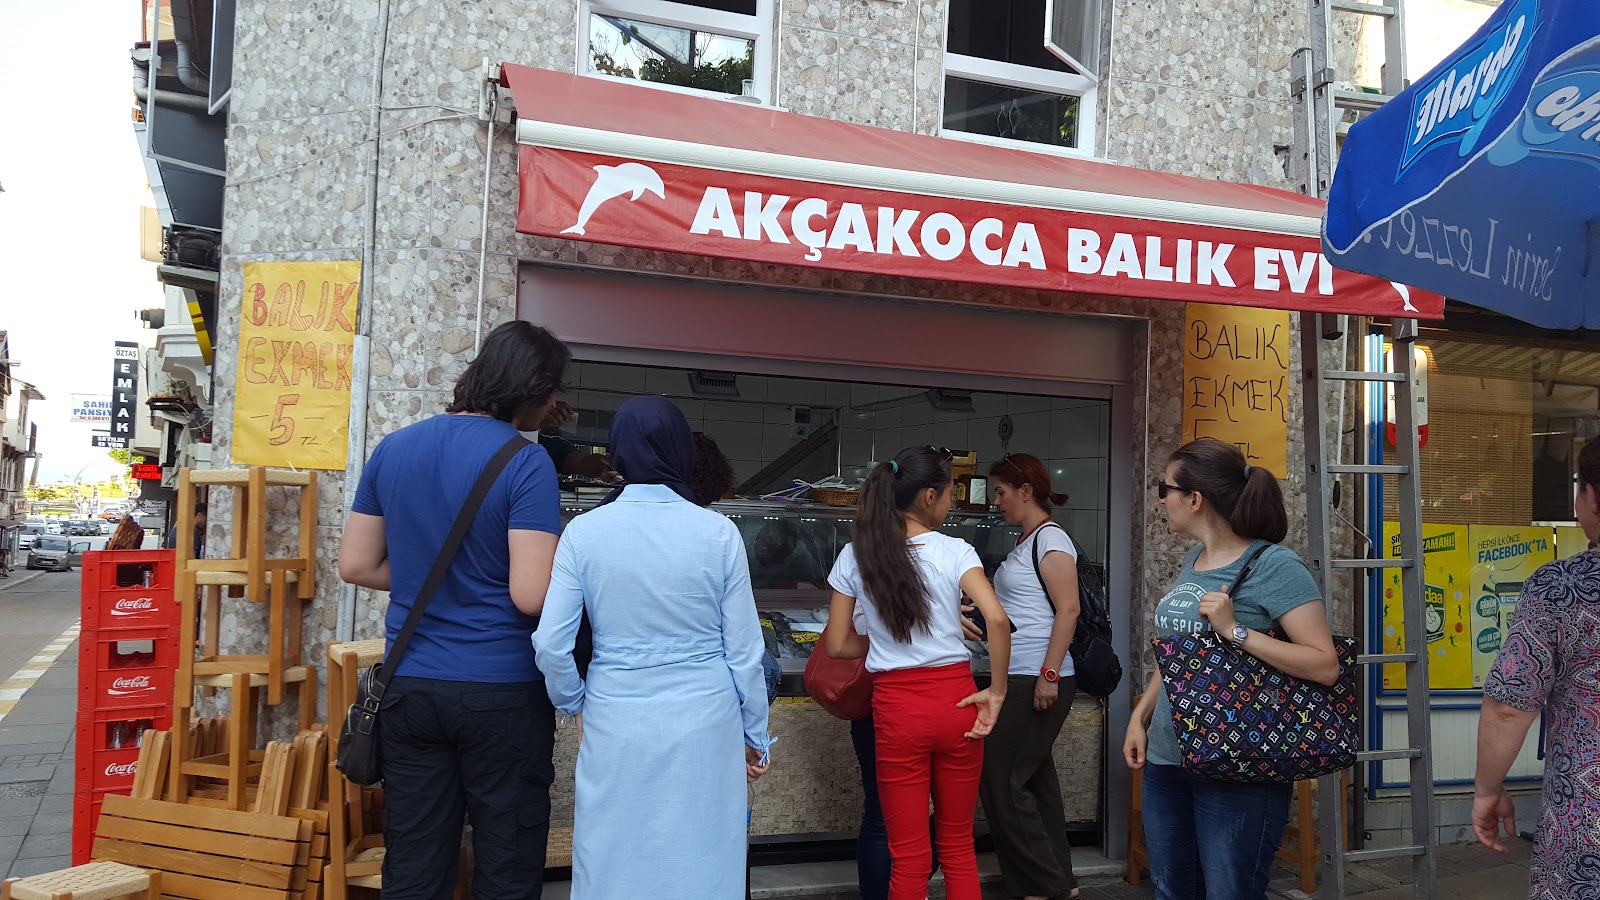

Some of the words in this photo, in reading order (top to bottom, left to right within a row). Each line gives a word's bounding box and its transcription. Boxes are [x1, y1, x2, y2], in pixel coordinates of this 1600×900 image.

[689, 187, 1047, 270] AKÇAKOCA
[1067, 228, 1236, 288] BALIK
[244, 280, 358, 331] BALIK
[115, 348, 137, 358] ÖZTAŞ
[1189, 320, 1287, 369] BALIK
[116, 363, 132, 432] EMLAK
[269, 394, 299, 446] 5
[1189, 374, 1287, 423] EKMEK
[105, 763, 138, 776] Coca-C
